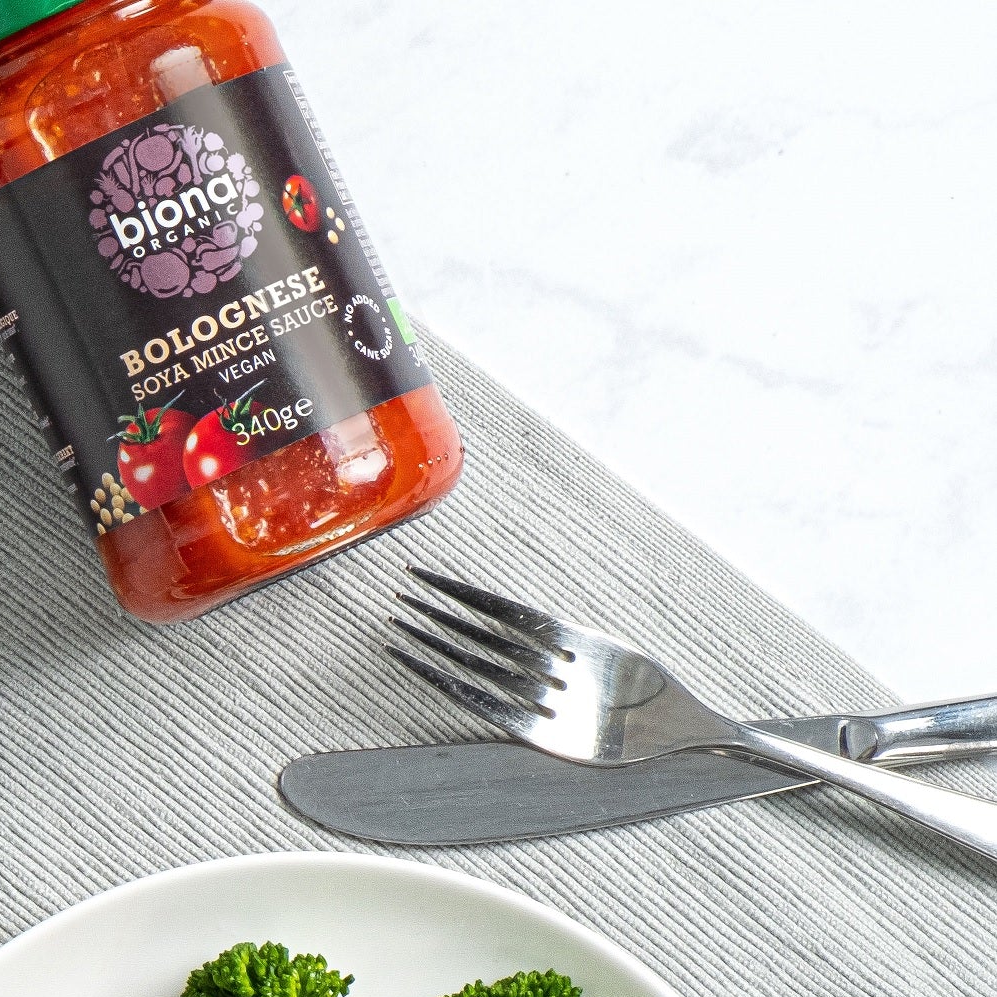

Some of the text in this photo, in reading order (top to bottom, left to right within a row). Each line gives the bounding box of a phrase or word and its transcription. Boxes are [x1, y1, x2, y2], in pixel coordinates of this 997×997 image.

[109, 173, 239, 249] biona
[133, 203, 239, 258] ORGANIC
[119, 265, 326, 377] BOLOGNESE
[344, 294, 380, 323] NO ADDED
[131, 294, 339, 401] SOYA MINCE SAUCE
[218, 348, 277, 383] VEGAN
[354, 326, 393, 361] CANE SUGAR
